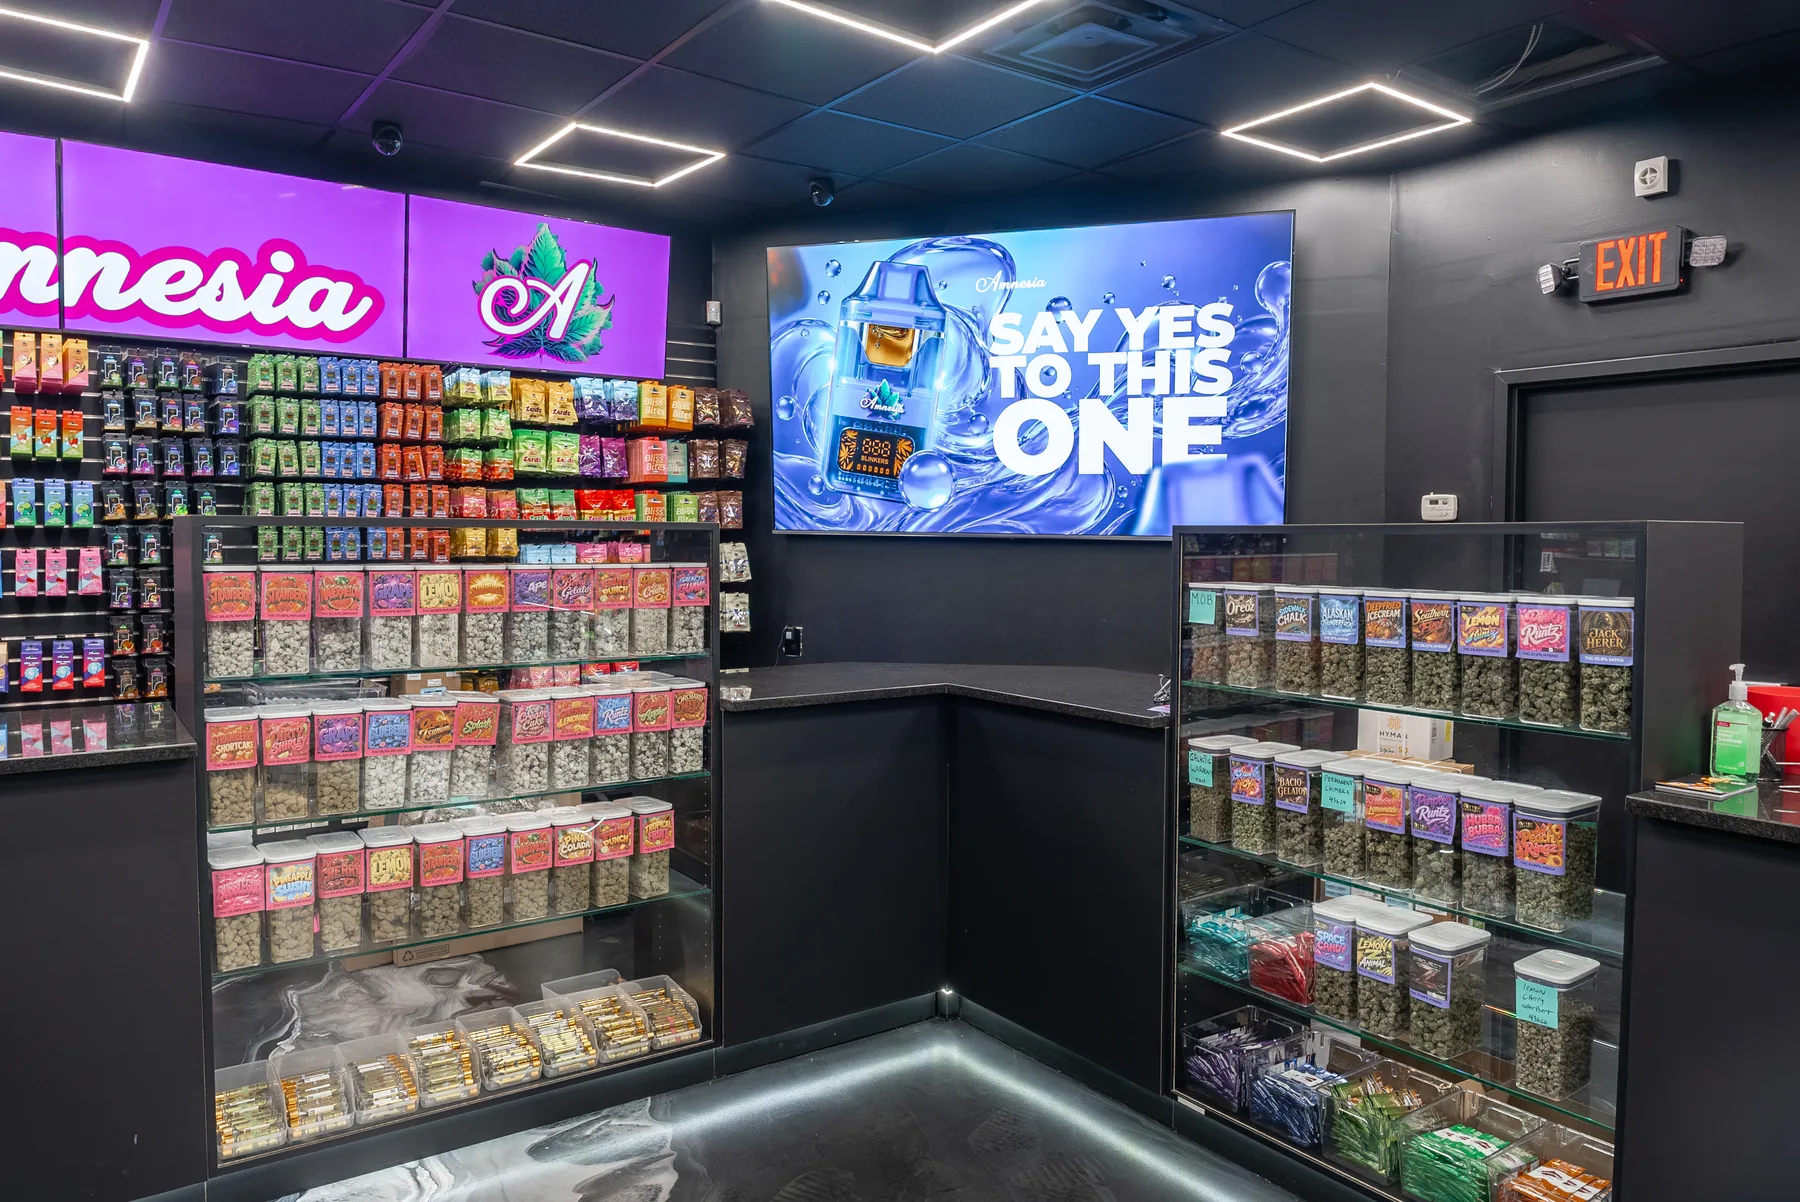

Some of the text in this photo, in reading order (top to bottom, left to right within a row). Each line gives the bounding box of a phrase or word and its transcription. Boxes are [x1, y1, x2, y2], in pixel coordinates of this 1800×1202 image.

[1596, 231, 1667, 291] EXIT
[975, 270, 1047, 293] Amnesia
[989, 302, 1236, 353] SAY YES
[989, 348, 1234, 398] TO THIS
[993, 396, 1228, 475] ONE
[374, 582, 413, 600] GRAPE
[421, 582, 460, 601] LEMON
[562, 586, 589, 599] Gelato
[602, 585, 629, 595] PUNCH
[1226, 601, 1255, 616] Oreoz
[1279, 604, 1307, 616] SIDEWALK
[1367, 601, 1402, 612] DEEPFRIED
[1277, 611, 1308, 626] CHALK
[1321, 607, 1353, 621] ALASKAN
[1367, 608, 1401, 621] ICECREAM
[1413, 608, 1450, 625] Southern
[1466, 615, 1500, 631] LEMON
[1521, 623, 1563, 646] Runtz
[1589, 628, 1619, 638] JACK
[1586, 638, 1627, 650] HERER
[676, 693, 704, 705] ORCHARD
[603, 707, 630, 725] Runtz
[462, 718, 492, 734] Splash
[522, 717, 545, 730] Cake
[319, 726, 359, 744] GRAPE
[215, 741, 254, 755] SHORTCAKE
[1278, 777, 1302, 787] BACIO
[1368, 805, 1399, 816] Lemonade
[1415, 806, 1451, 825] Runtz
[644, 820, 672, 833] TROPICAL
[1465, 814, 1502, 826] HUBBA
[648, 828, 670, 841] FRUIT
[1467, 824, 1501, 838] BUBBA
[1518, 829, 1557, 844] Peach
[602, 834, 630, 846] PUNCH
[560, 841, 591, 854] COLADA
[1522, 842, 1558, 859] Ringz
[371, 856, 411, 875] LEMON
[271, 871, 313, 887] PINEAPPLE
[1316, 931, 1346, 945] SPACE
[1358, 937, 1387, 951] LEMON
[1316, 942, 1347, 954] CANDY
[1358, 959, 1386, 968] ANIMAL
[1412, 956, 1443, 970] PROJECT
